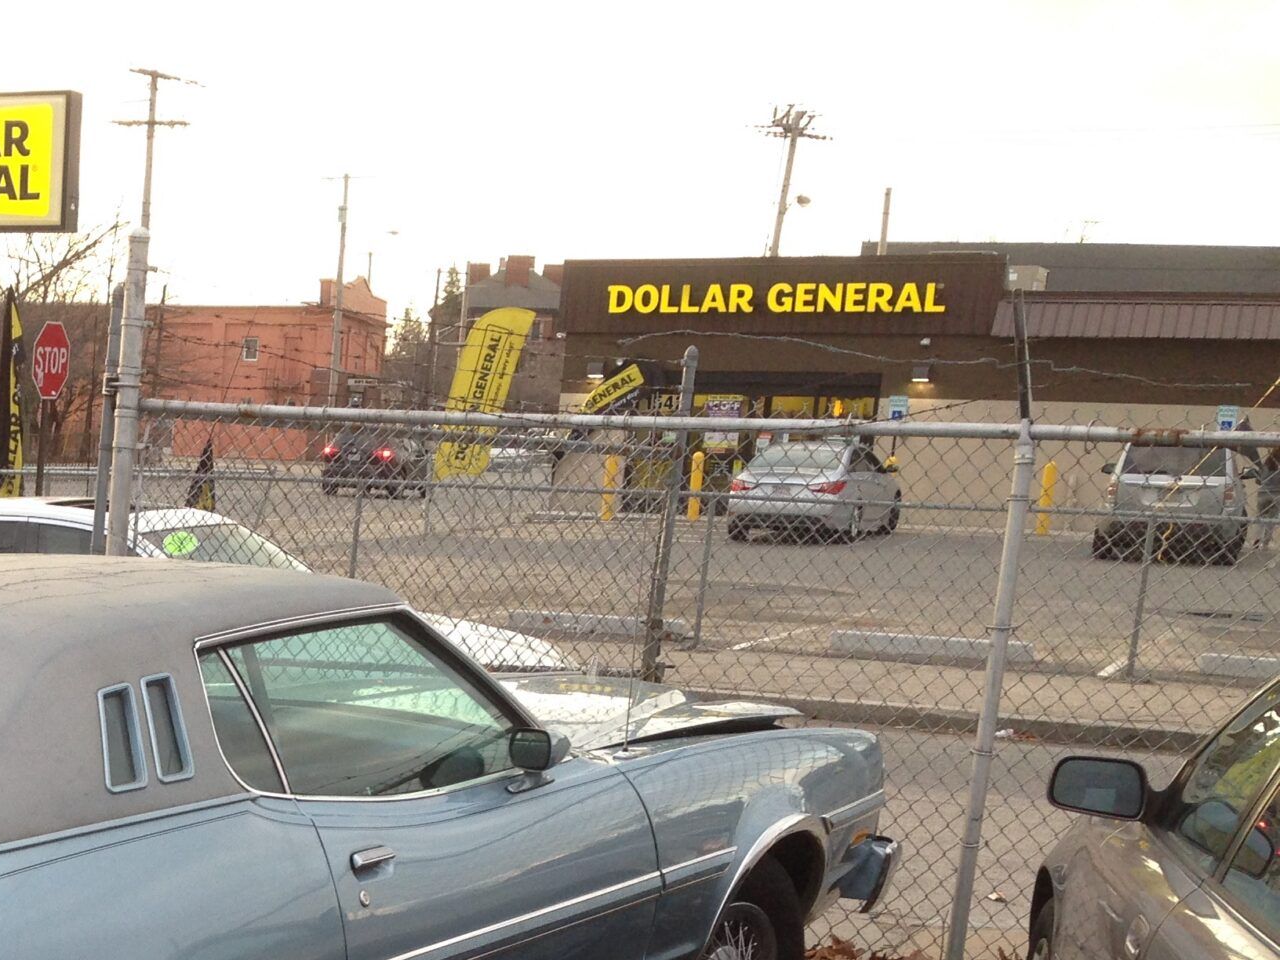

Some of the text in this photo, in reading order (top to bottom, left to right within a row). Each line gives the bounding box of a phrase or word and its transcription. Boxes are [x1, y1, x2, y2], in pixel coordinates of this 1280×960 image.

[608, 282, 946, 313] DOLLAR GENERAL
[35, 346, 68, 375] STOP
[473, 335, 502, 400] GENERAL
[586, 374, 637, 409] GENERAL
